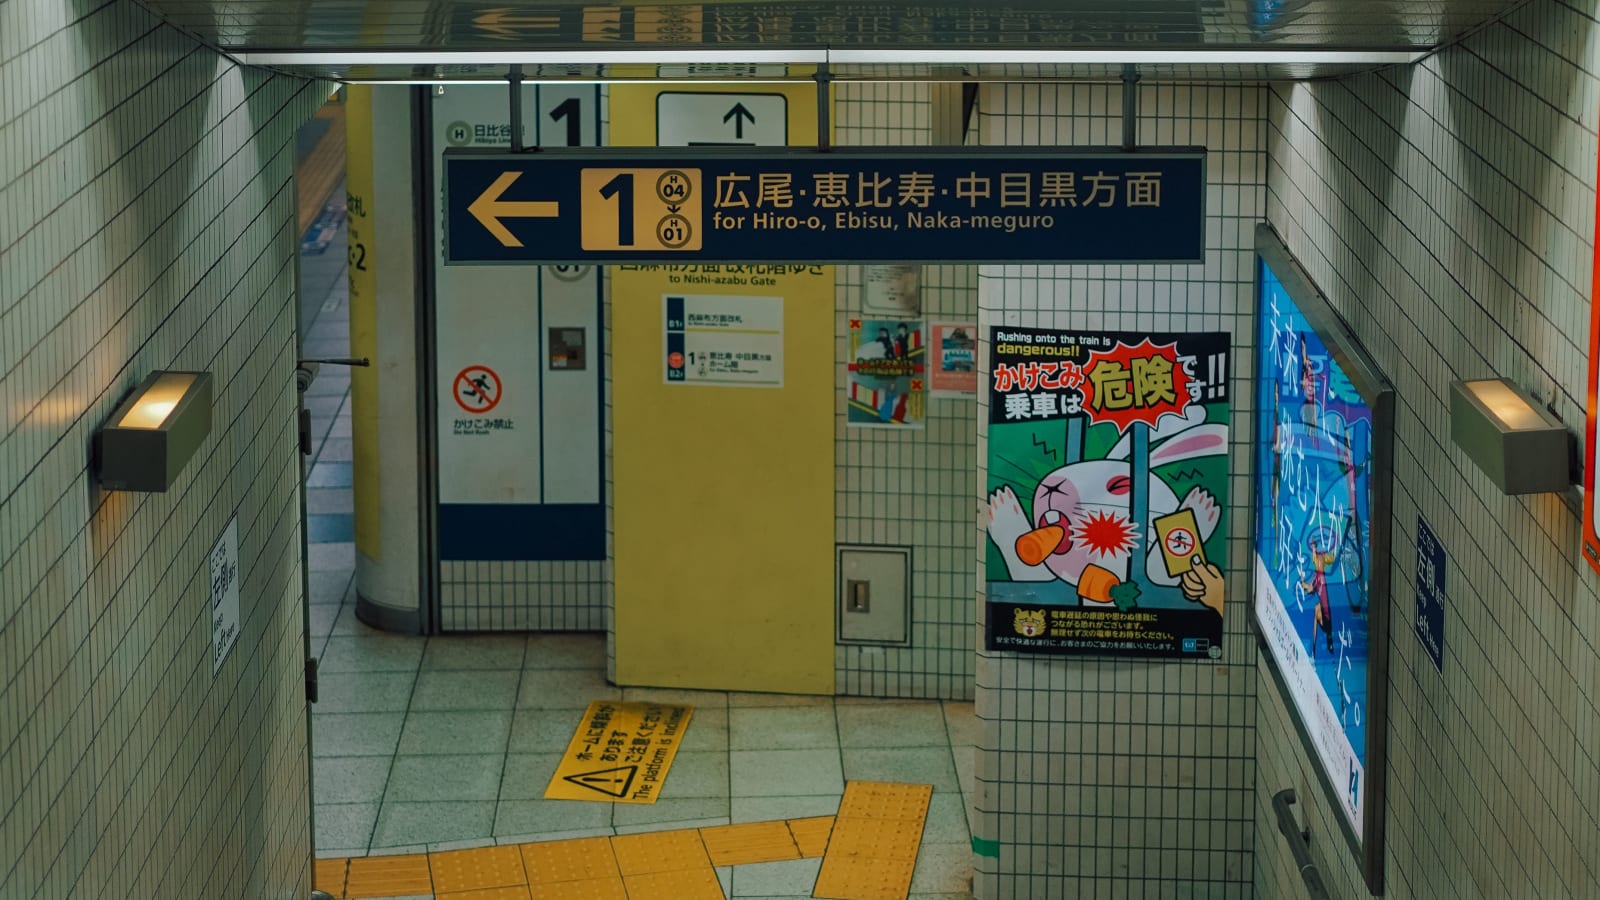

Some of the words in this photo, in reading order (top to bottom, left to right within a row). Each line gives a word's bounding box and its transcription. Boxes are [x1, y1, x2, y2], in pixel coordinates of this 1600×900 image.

[455, 130, 464, 139] H
[475, 124, 525, 137] 日比谷
[663, 184, 684, 197] 04
[713, 171, 1163, 209] 広尾・恵比寿・中目黒方面
[599, 173, 634, 246] 1
[713, 211, 744, 230] for
[753, 212, 828, 232] Hiro-o,
[835, 212, 899, 232] Ebisu,
[907, 212, 1055, 233] Naka-meguro
[663, 228, 683, 241] 01
[669, 275, 681, 283] to
[684, 274, 747, 285] Nishi-azabu
[750, 276, 776, 286] Gate
[997, 331, 1032, 343] Rushing
[1035, 334, 1056, 344] onto
[1060, 334, 1076, 344] the
[1079, 335, 1099, 346] train
[1103, 336, 1111, 346] is
[997, 343, 1080, 358] dangerous!!
[994, 360, 1085, 392] かけこみ
[1088, 354, 1177, 412] 危険
[1004, 391, 1082, 420] 乗車は
[454, 419, 514, 430] かけこみ禁止
[600, 730, 628, 762] あります
[641, 747, 668, 783] platform
[632, 784, 653, 800] The
